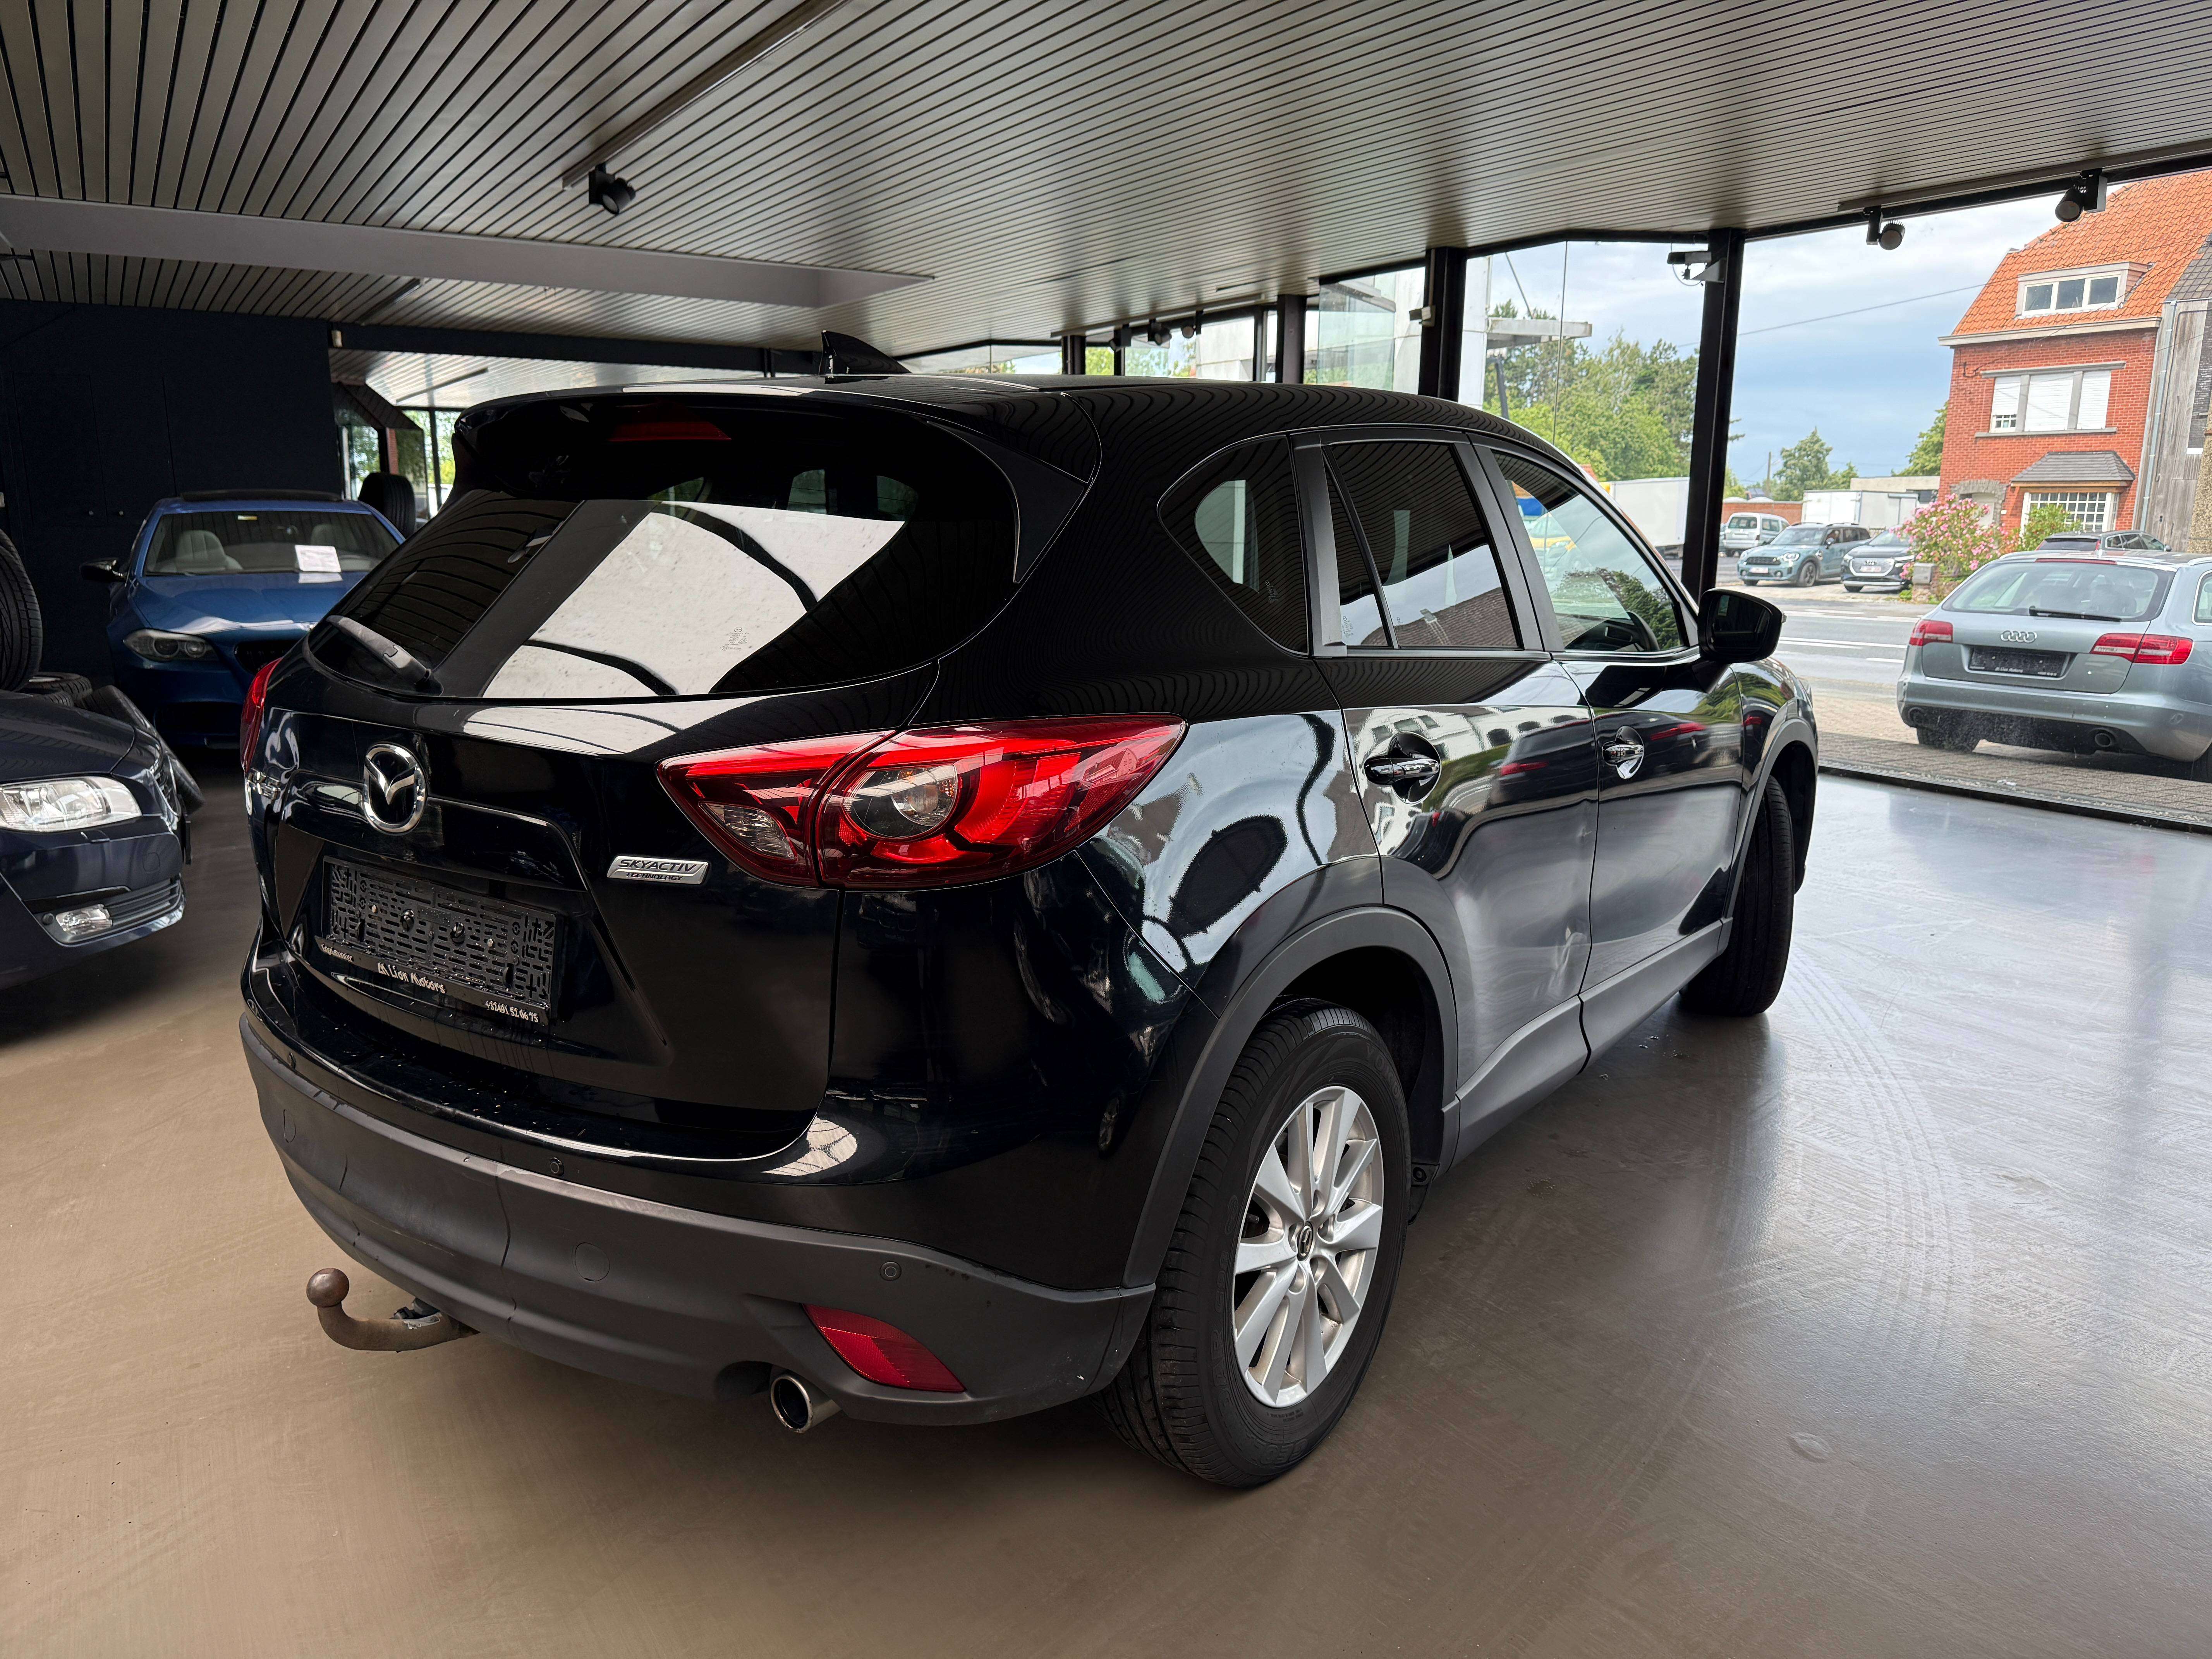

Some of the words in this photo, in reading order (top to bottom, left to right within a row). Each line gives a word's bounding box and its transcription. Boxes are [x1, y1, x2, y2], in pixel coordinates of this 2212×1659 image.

[618, 859, 697, 872] SKYACTIV
[625, 872, 684, 881] TECHNOLOGY
[388, 964, 409, 982] Lion
[410, 972, 446, 994] Motors
[510, 1006, 519, 1018] 52
[519, 1009, 529, 1021] 06
